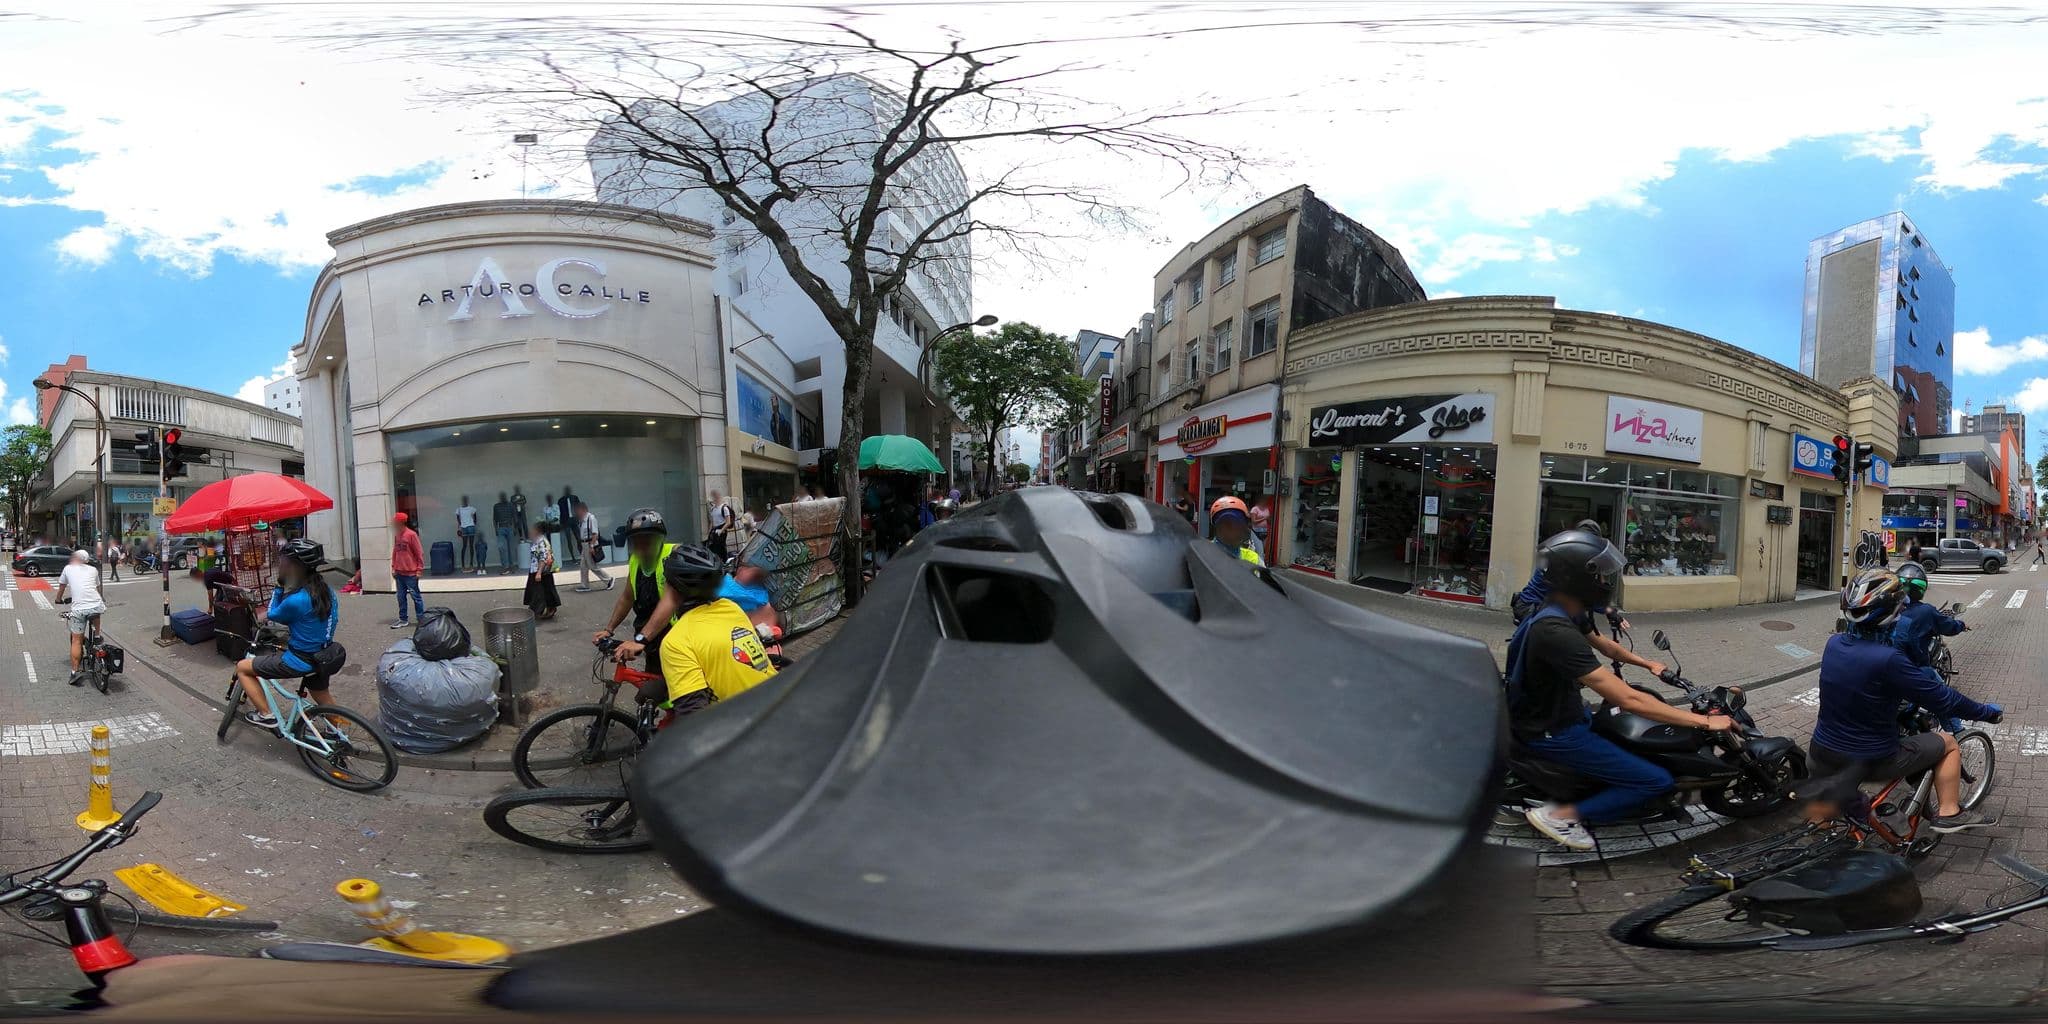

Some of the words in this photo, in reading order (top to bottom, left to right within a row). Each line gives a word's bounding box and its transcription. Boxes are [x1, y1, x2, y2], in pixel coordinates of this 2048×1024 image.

[418, 282, 535, 306] ARTURO
[558, 283, 650, 303] CALLE
[448, 256, 611, 321] AC
[1103, 379, 1111, 426] HOTEL
[1312, 405, 1407, 437] Laurent's
[1664, 427, 1696, 445] shoes
